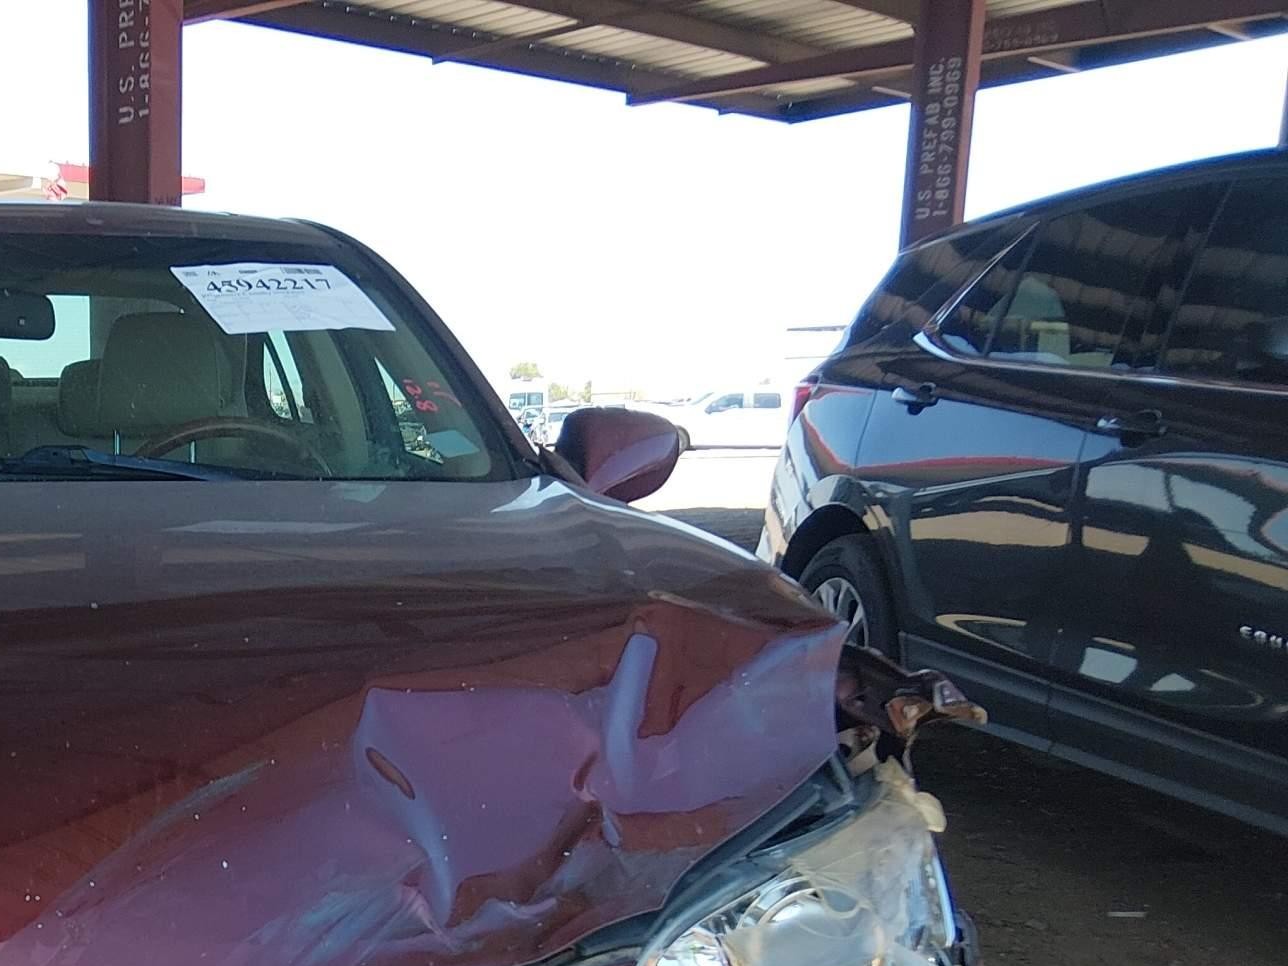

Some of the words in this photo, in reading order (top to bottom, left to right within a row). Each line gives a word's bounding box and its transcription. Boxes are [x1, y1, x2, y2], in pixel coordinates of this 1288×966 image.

[119, 64, 134, 124] U.S.
[929, 57, 945, 93] INC.
[920, 102, 941, 174] PREFAB
[933, 57, 962, 216] 1-866-799-0969
[206, 278, 332, 294] 45942217
